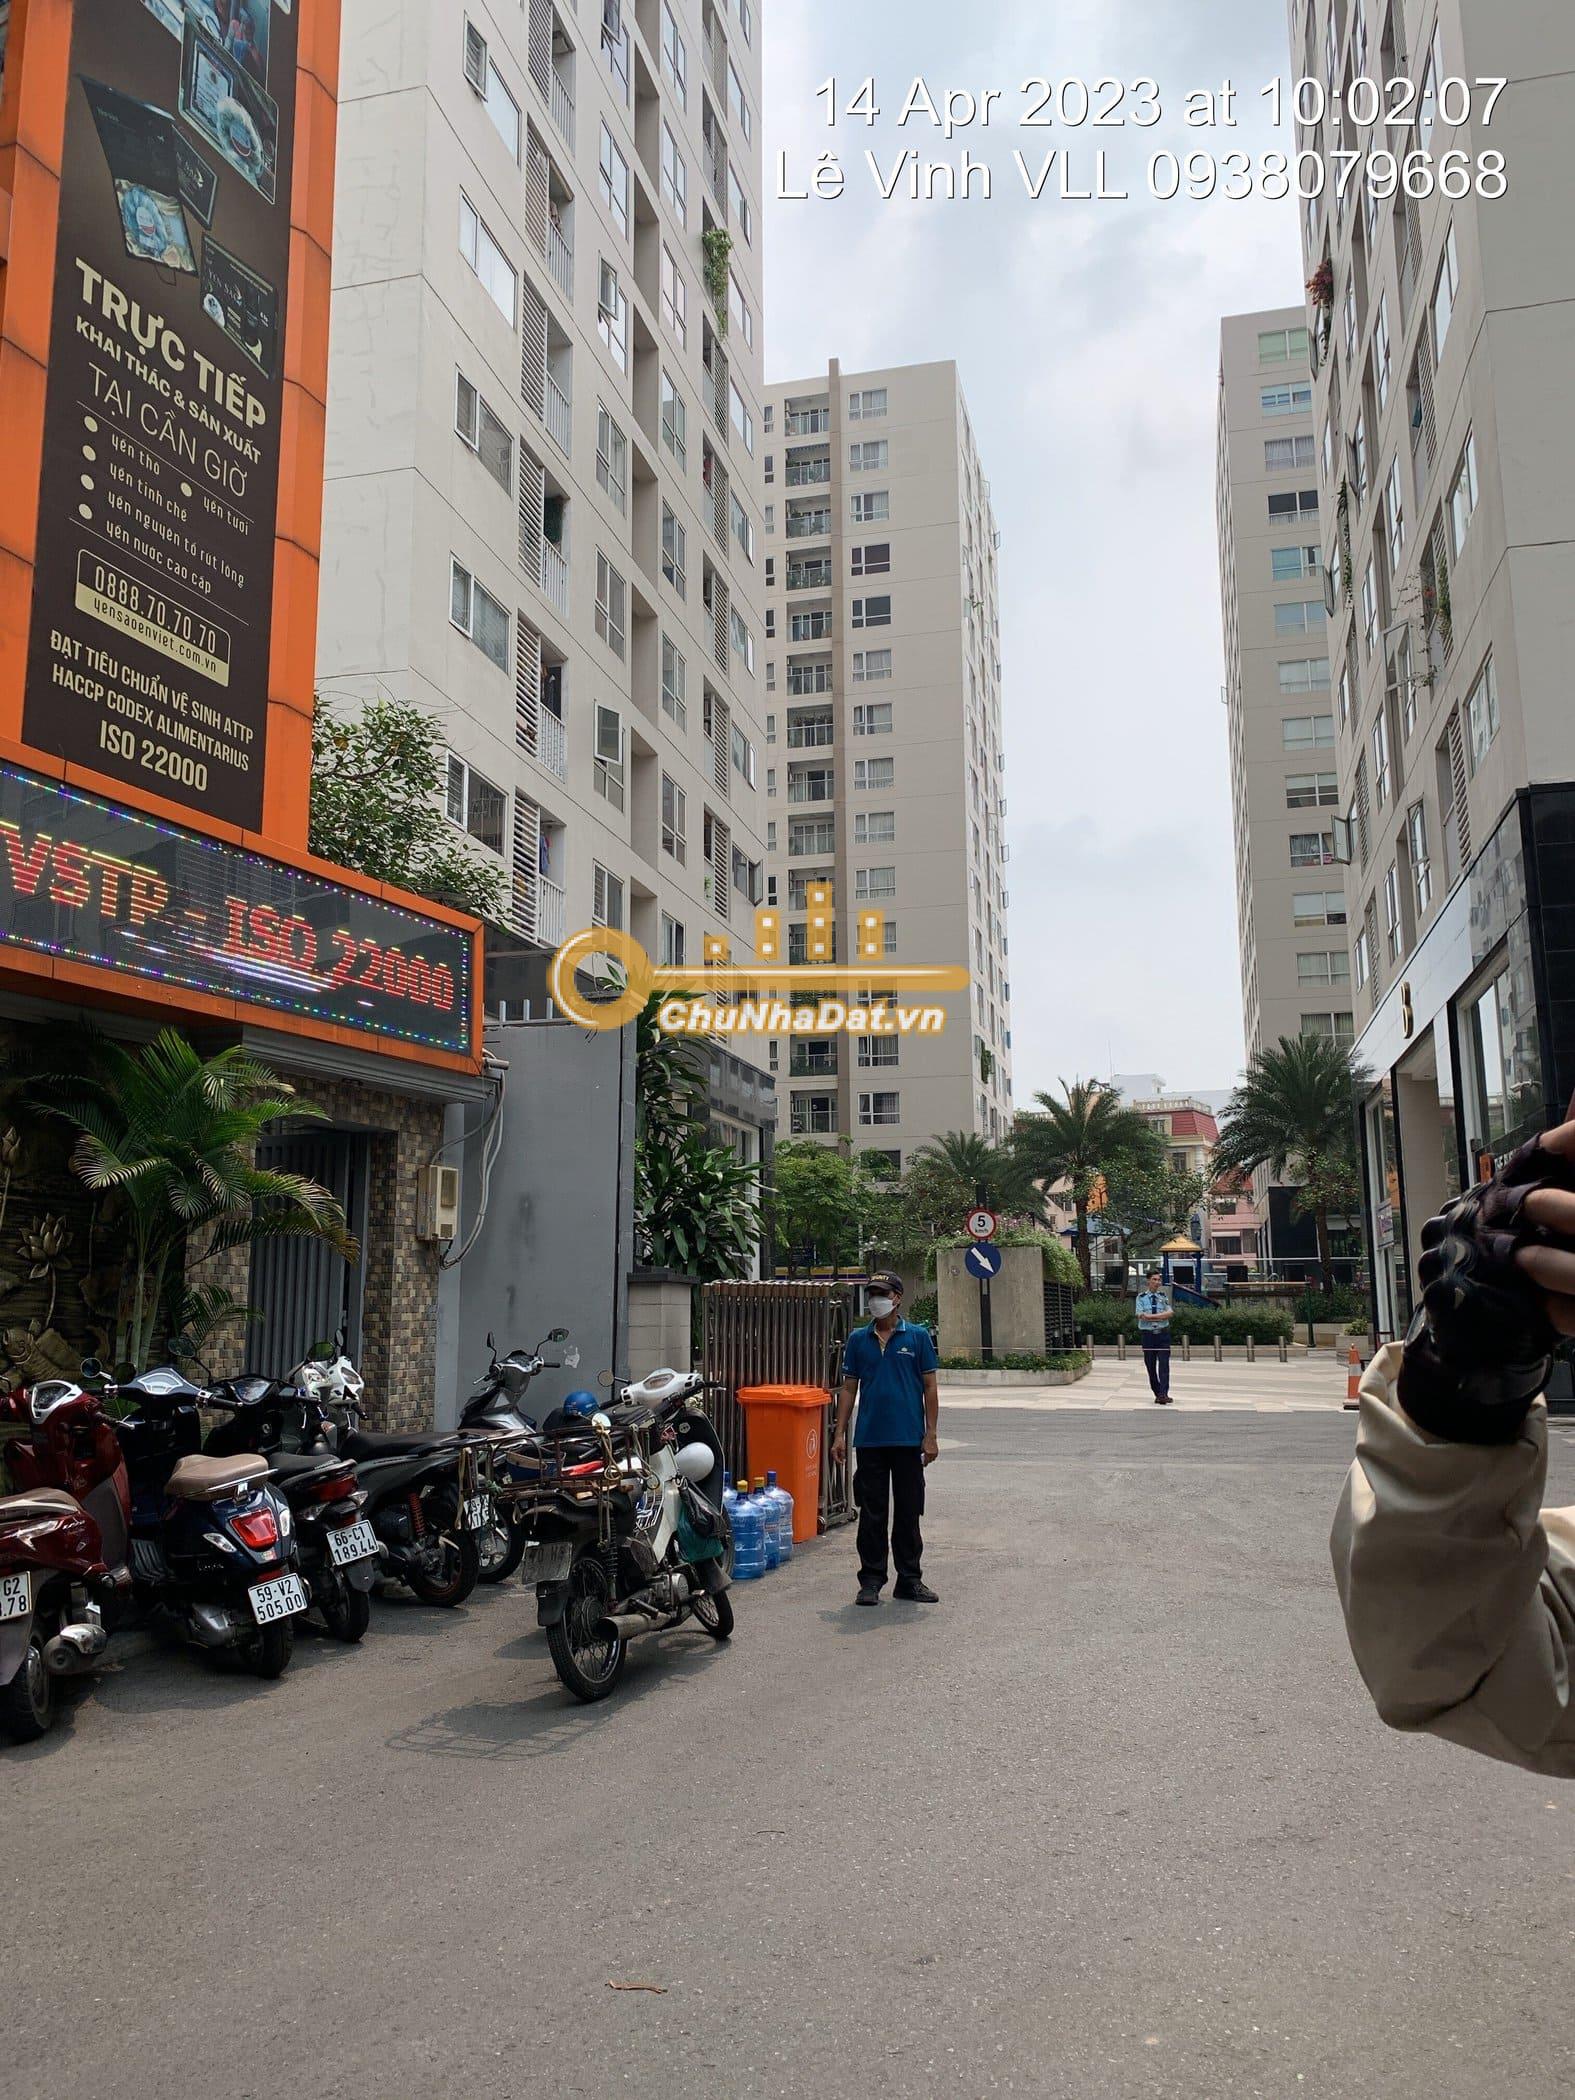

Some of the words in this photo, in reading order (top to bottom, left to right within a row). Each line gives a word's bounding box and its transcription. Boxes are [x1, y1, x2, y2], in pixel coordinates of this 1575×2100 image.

[75, 256, 186, 372] TRỰC
[193, 350, 267, 430] TIẾP
[76, 314, 121, 362] KHAI
[125, 351, 171, 398] THÁC
[174, 389, 186, 411] &
[223, 425, 261, 465] XUẤT
[88, 361, 131, 419] TẠI
[140, 402, 197, 465] CẦN
[204, 449, 248, 497] GIỜ
[166, 557, 188, 580] cao
[94, 597, 217, 674] yensaoenviet.com.vn
[95, 565, 217, 655] 0888.70.70.70
[50, 629, 82, 660] ĐẠT
[85, 646, 118, 679] TIÊU
[121, 665, 168, 704] CHUẨN
[171, 689, 189, 717] VỆ
[191, 700, 221, 730] SINH
[223, 716, 254, 744] ATTP
[52, 663, 104, 702] HACCP
[107, 690, 154, 728] CODEX
[156, 713, 249, 771] ALIMENTARIUS
[99, 719, 135, 760] ISO
[141, 739, 208, 791] 22000
[332, 929, 455, 1010] 22000
[977, 1215, 986, 1228] 5
[334, 1526, 366, 1547] 66-C1
[334, 1538, 375, 1566] 189.44
[0, 1595, 27, 1618] .78
[257, 1579, 294, 1603] 59-V2
[257, 1593, 303, 1621] 505.00
